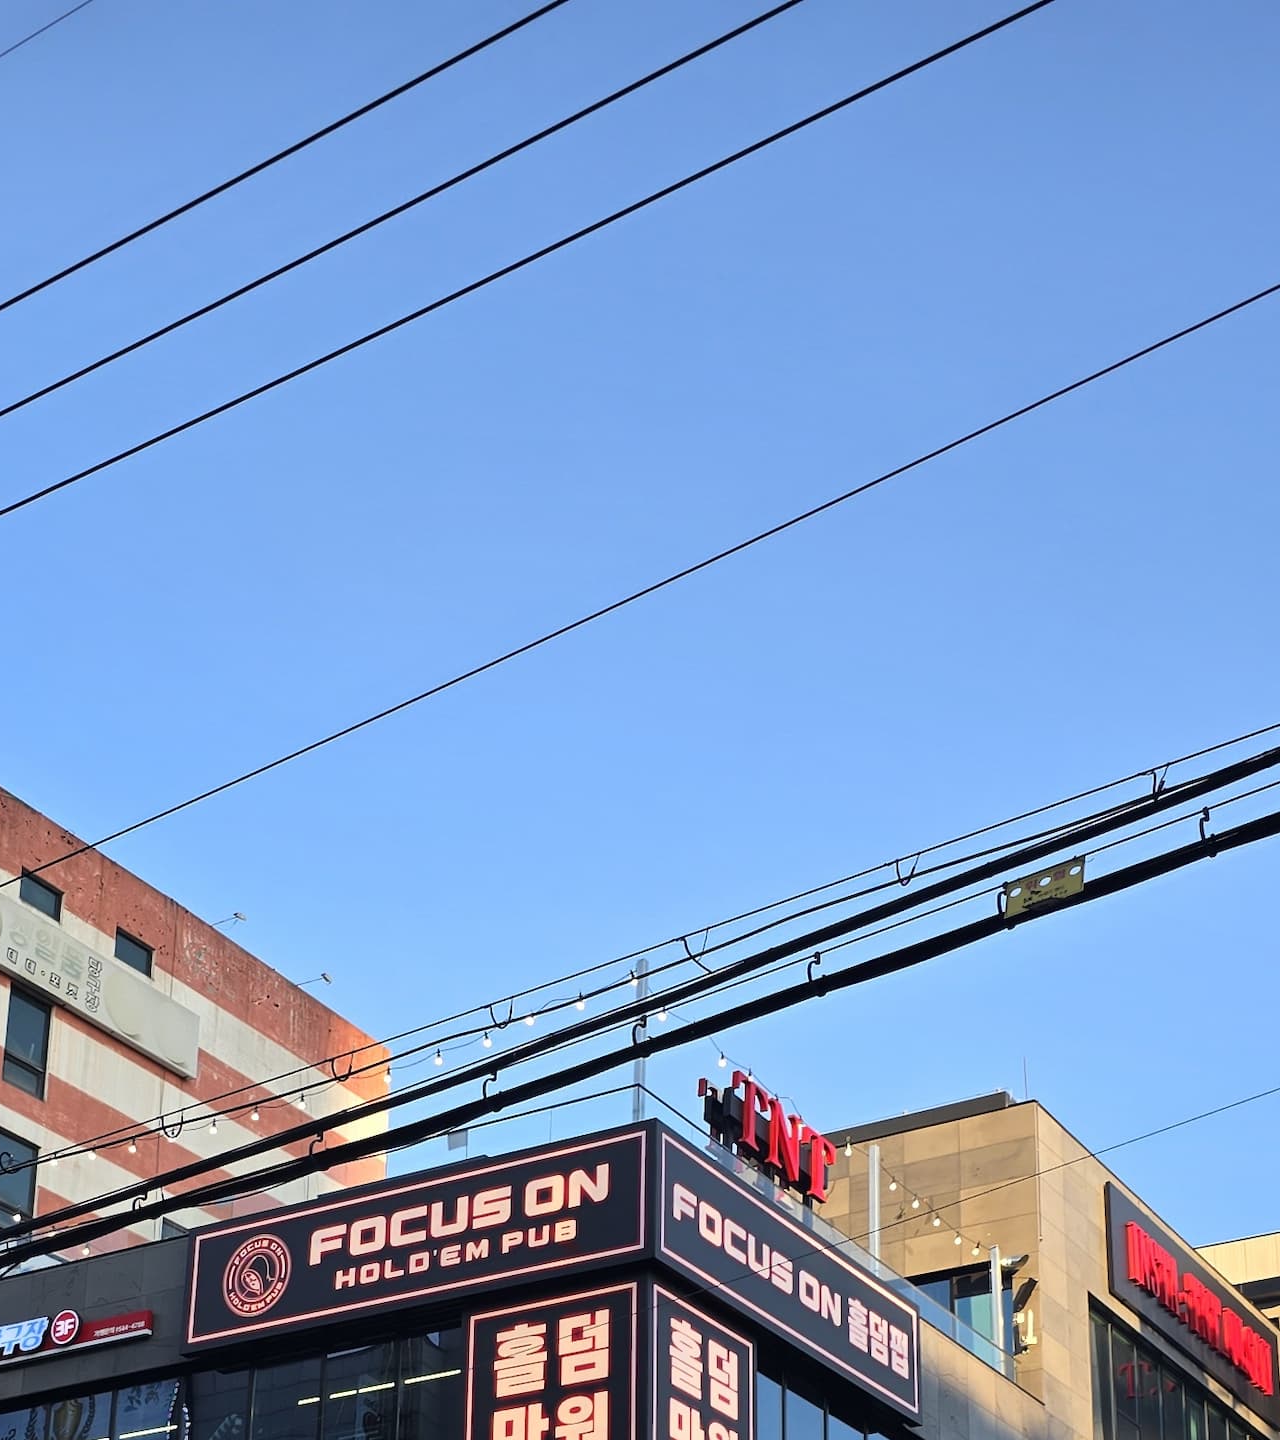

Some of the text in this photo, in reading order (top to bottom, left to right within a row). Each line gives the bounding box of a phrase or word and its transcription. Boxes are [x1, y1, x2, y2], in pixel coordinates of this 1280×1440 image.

[732, 1070, 836, 1203] TNT
[308, 1162, 609, 1267] FOCUS ON
[334, 1219, 577, 1292] HOLD'EM PUB
[55, 1319, 75, 1337] 3F
[672, 1183, 911, 1381] FOCUS ON 홀덤펍
[494, 1307, 612, 1399] 홀덤
[668, 1316, 740, 1421] 홀덤
